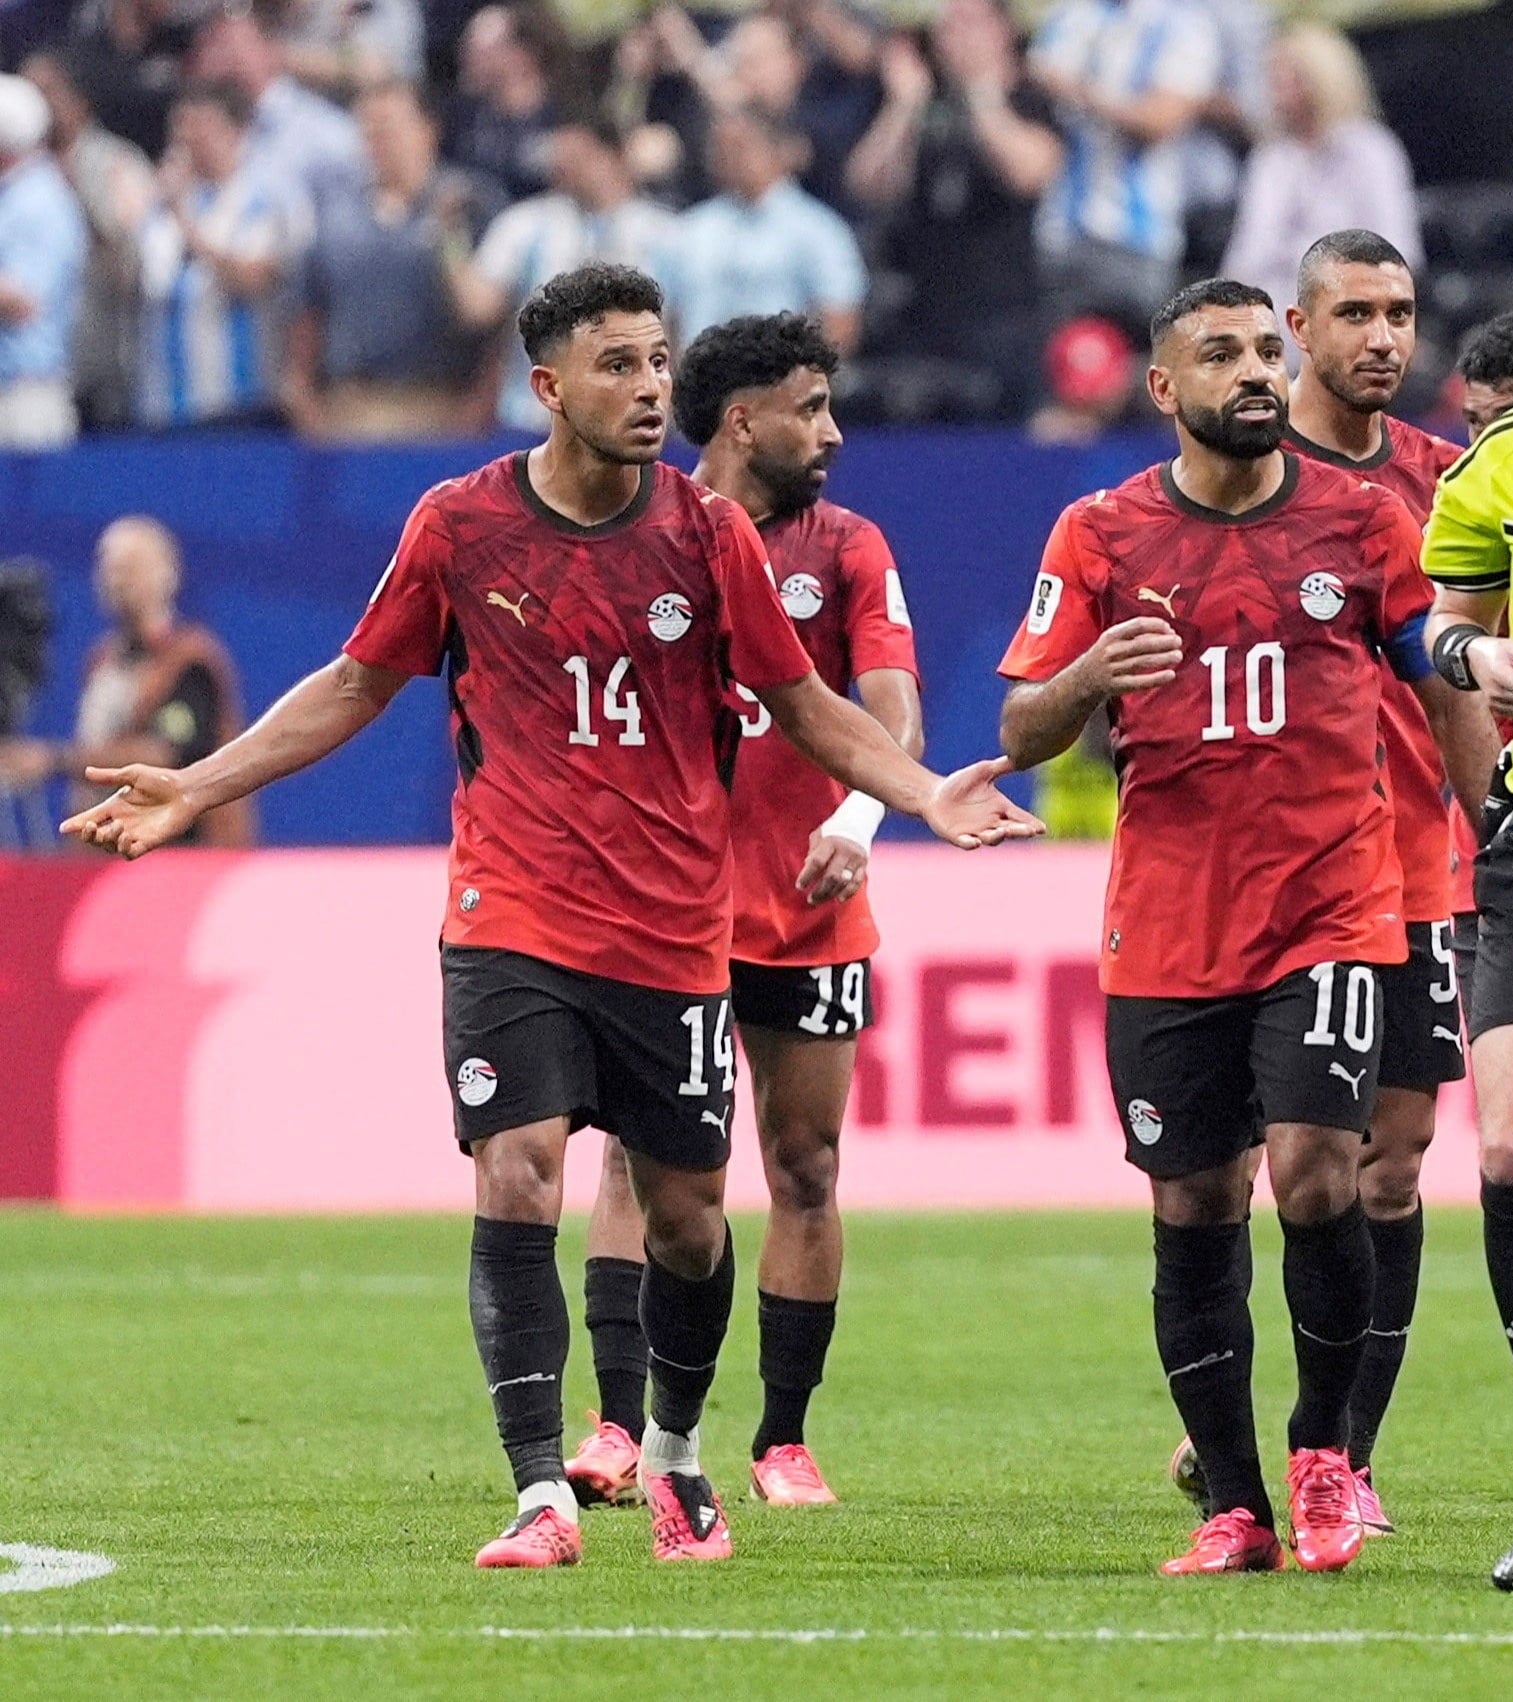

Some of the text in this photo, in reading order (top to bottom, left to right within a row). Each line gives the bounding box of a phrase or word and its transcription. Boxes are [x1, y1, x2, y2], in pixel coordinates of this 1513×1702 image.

[563, 655, 646, 747] 14
[1199, 641, 1287, 741] 10
[798, 962, 865, 1034] 19
[1304, 960, 1375, 1053] 10
[678, 999, 734, 1096] 14
